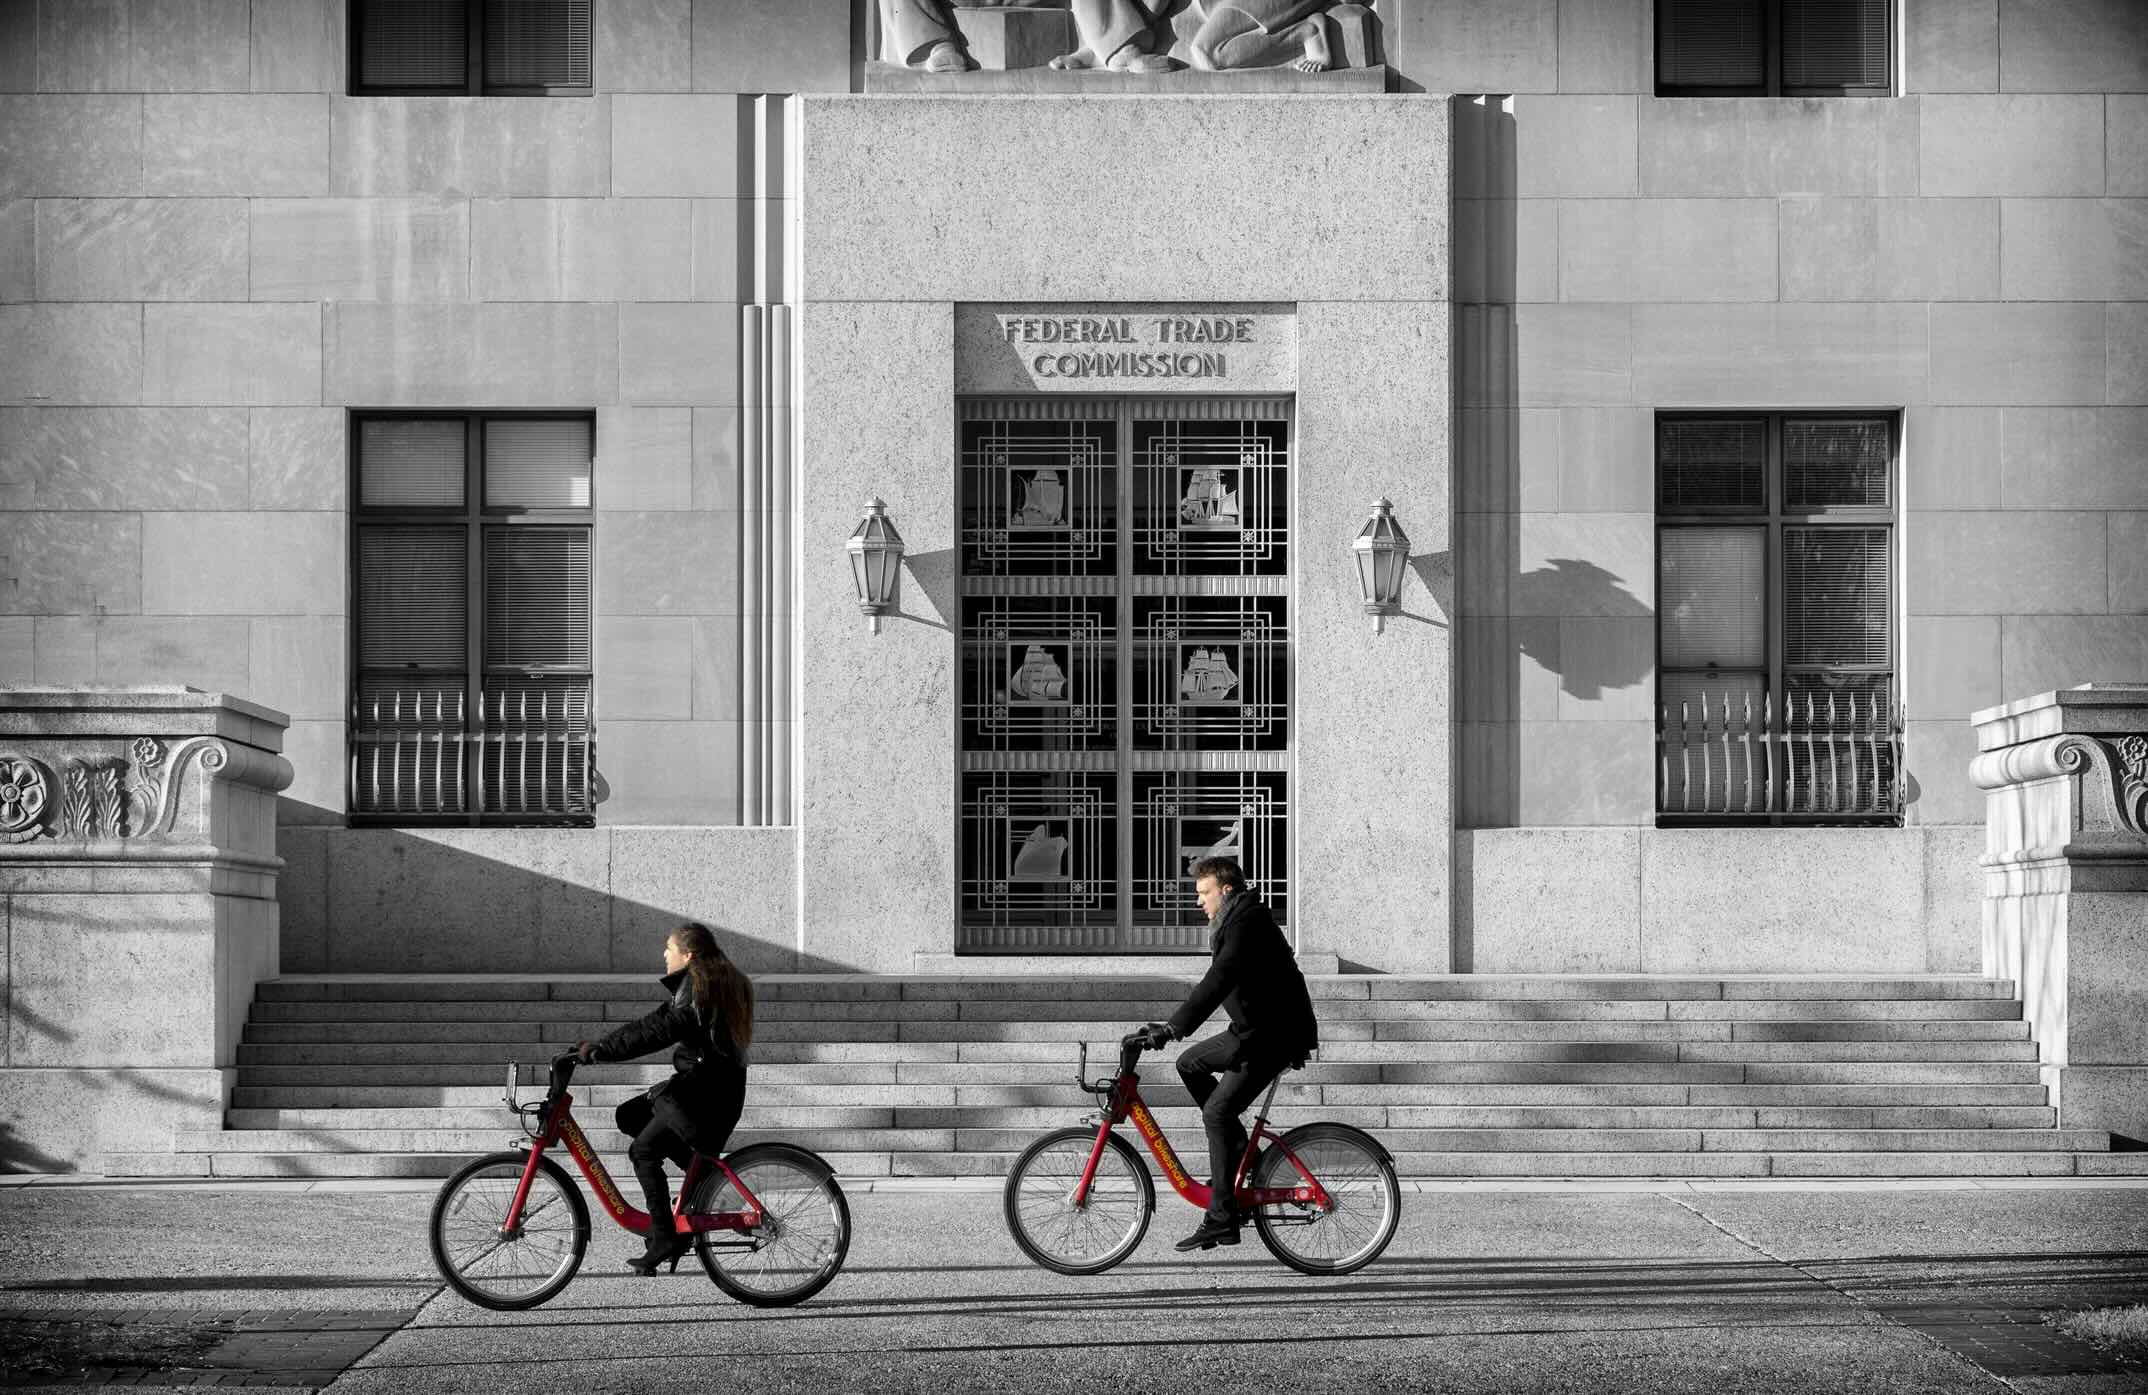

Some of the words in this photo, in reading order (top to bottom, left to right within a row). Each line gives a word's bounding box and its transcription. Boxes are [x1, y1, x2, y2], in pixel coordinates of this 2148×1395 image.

[1003, 318, 1137, 343] FEDERAL
[1153, 318, 1256, 343] TRADE
[1033, 352, 1226, 378] COMMISSION
